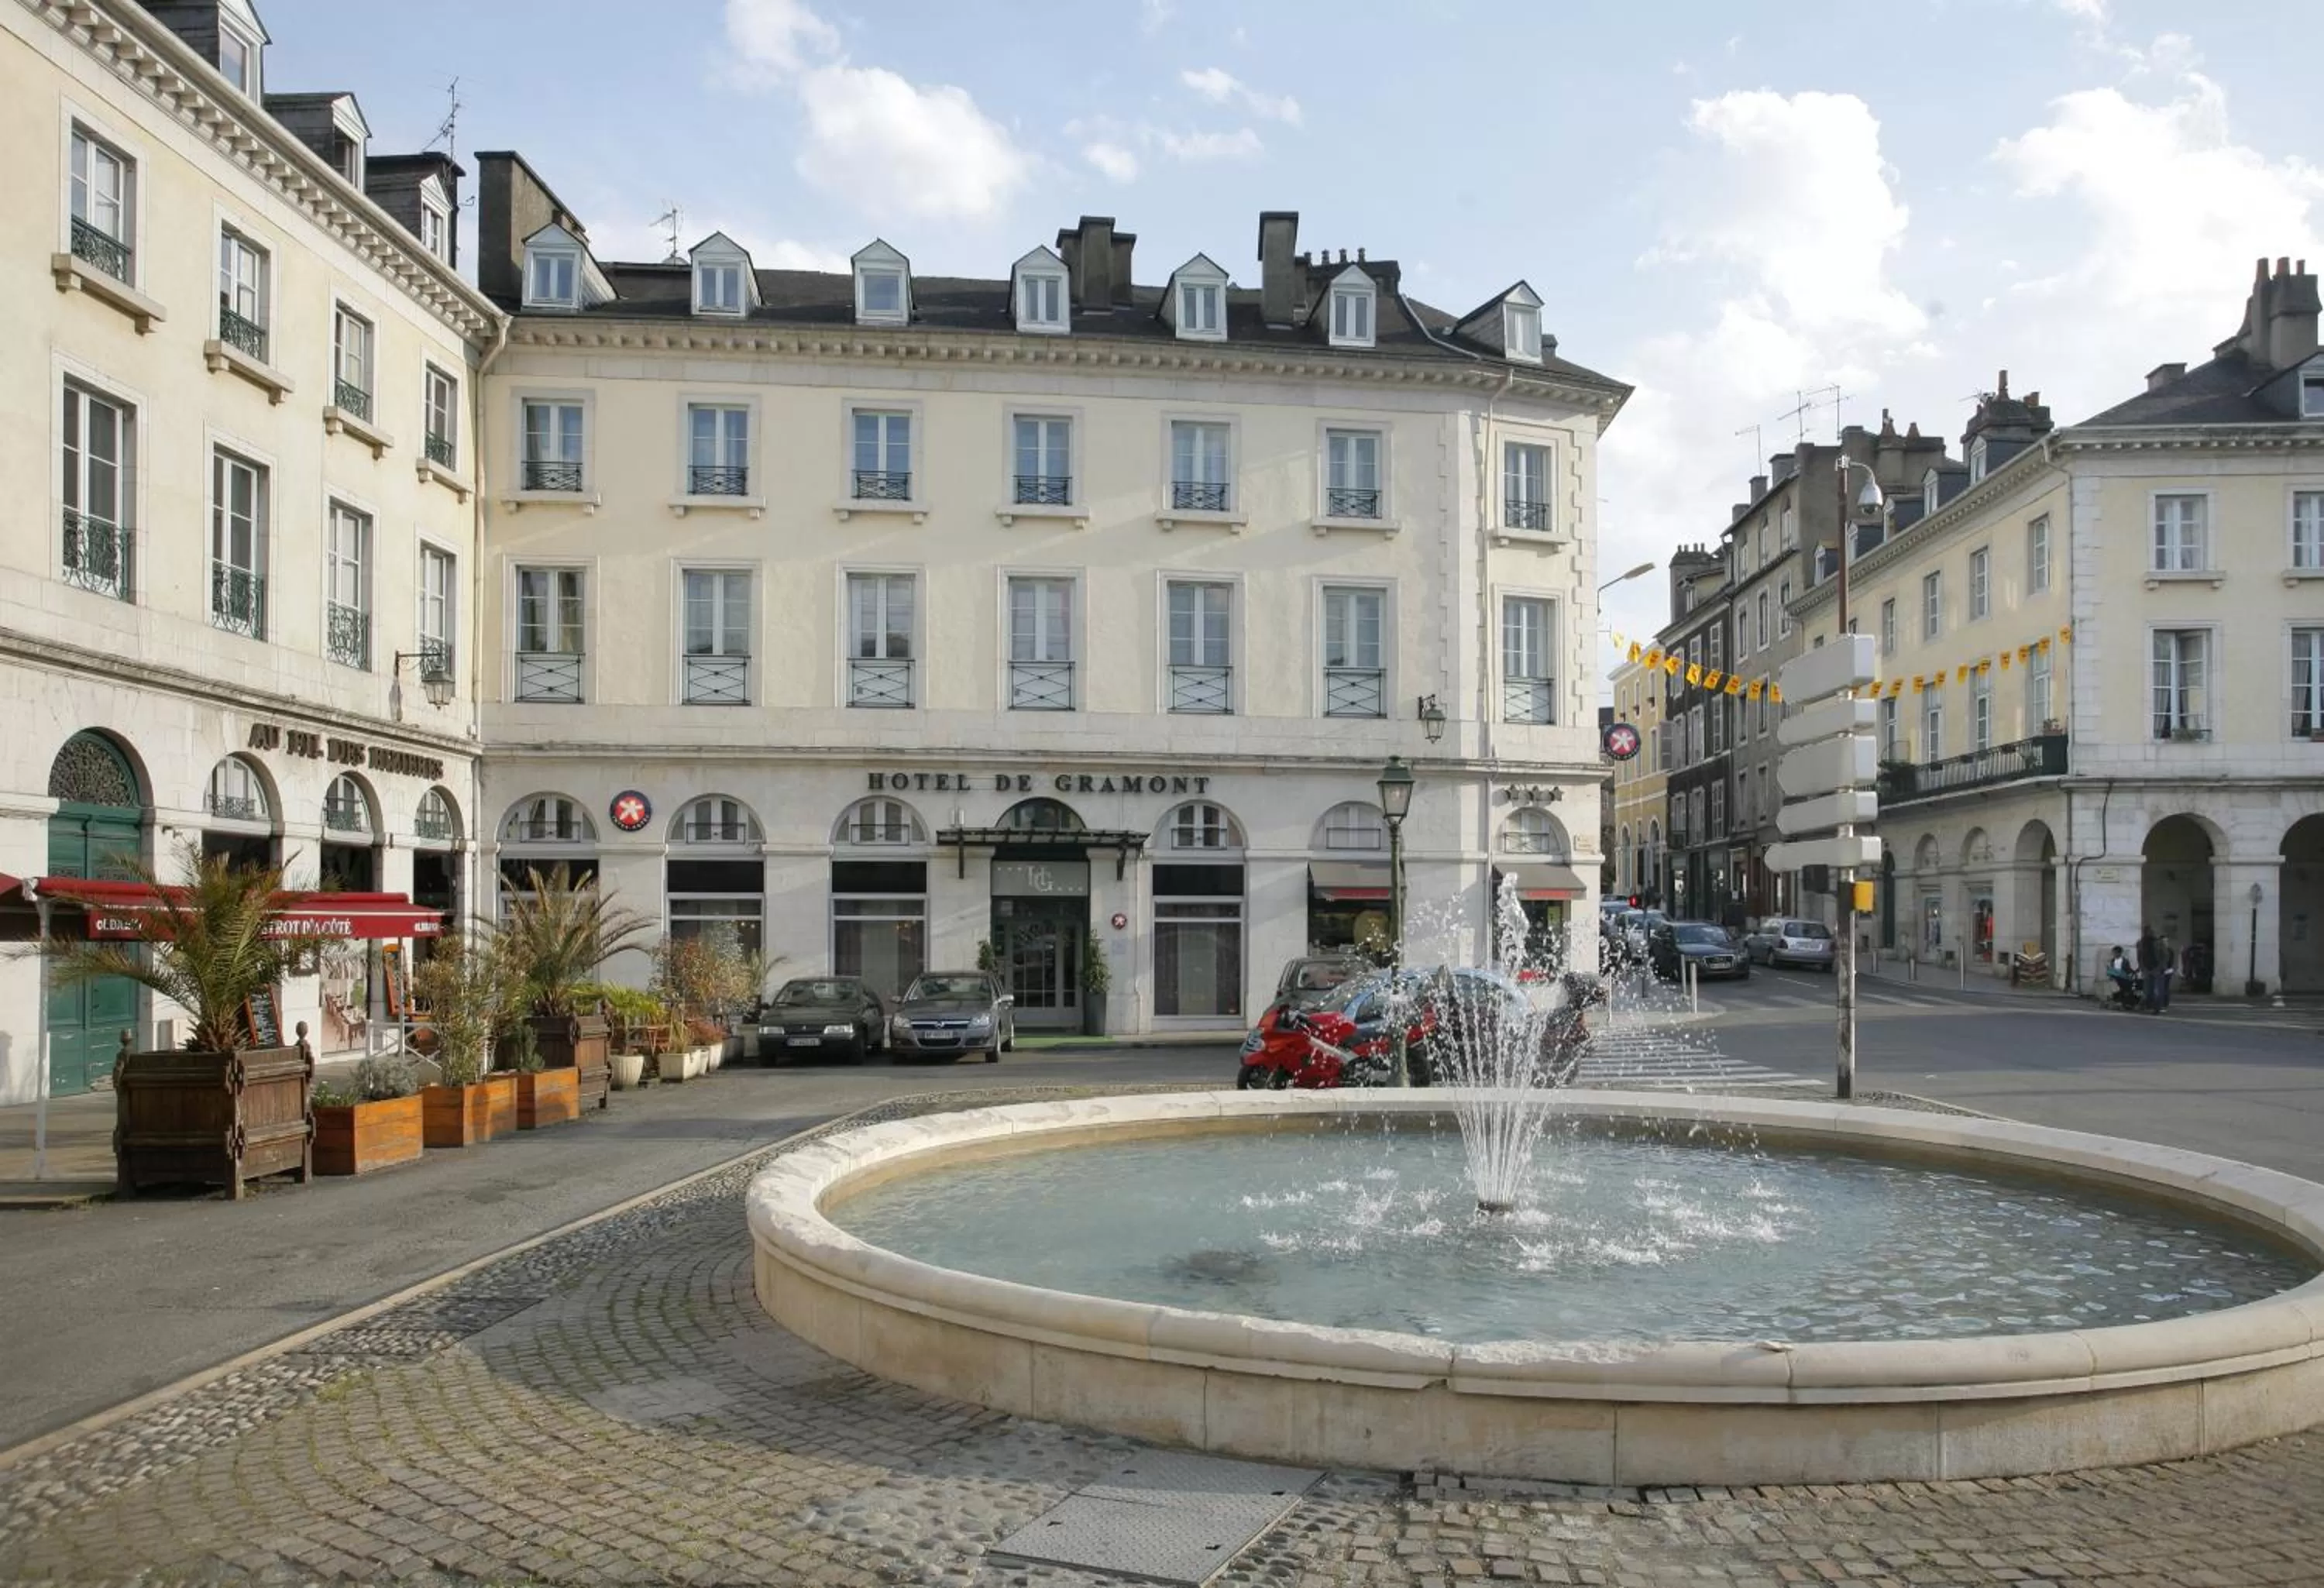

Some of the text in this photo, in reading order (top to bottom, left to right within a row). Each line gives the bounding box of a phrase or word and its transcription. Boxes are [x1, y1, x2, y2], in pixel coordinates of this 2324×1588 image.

[248, 723, 281, 751] AU
[327, 737, 366, 766] DES
[868, 773, 1210, 794] HOTEL DE GRAMONT
